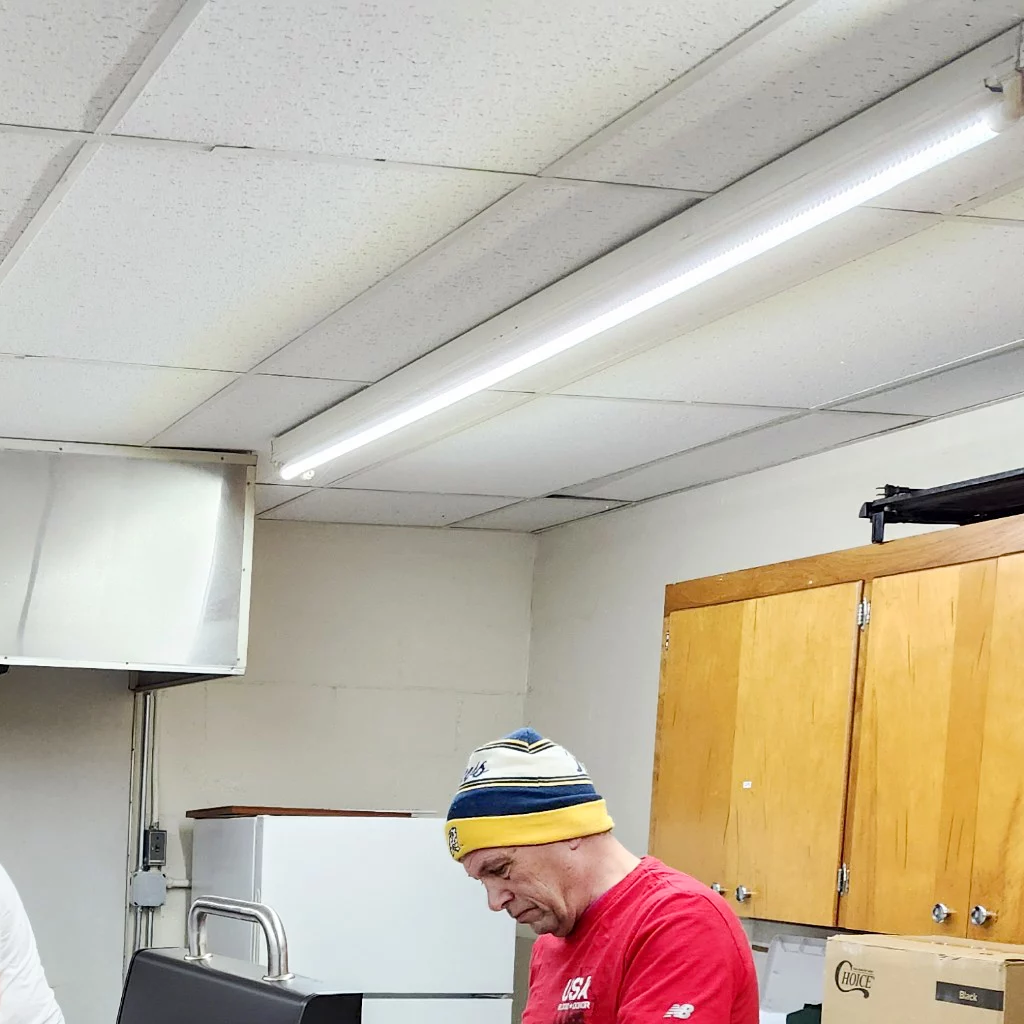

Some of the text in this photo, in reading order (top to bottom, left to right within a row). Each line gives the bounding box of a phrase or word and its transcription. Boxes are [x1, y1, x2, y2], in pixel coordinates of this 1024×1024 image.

[561, 975, 592, 1002] USA
[835, 960, 873, 999] CHOICE
[959, 990, 978, 1002] Black
